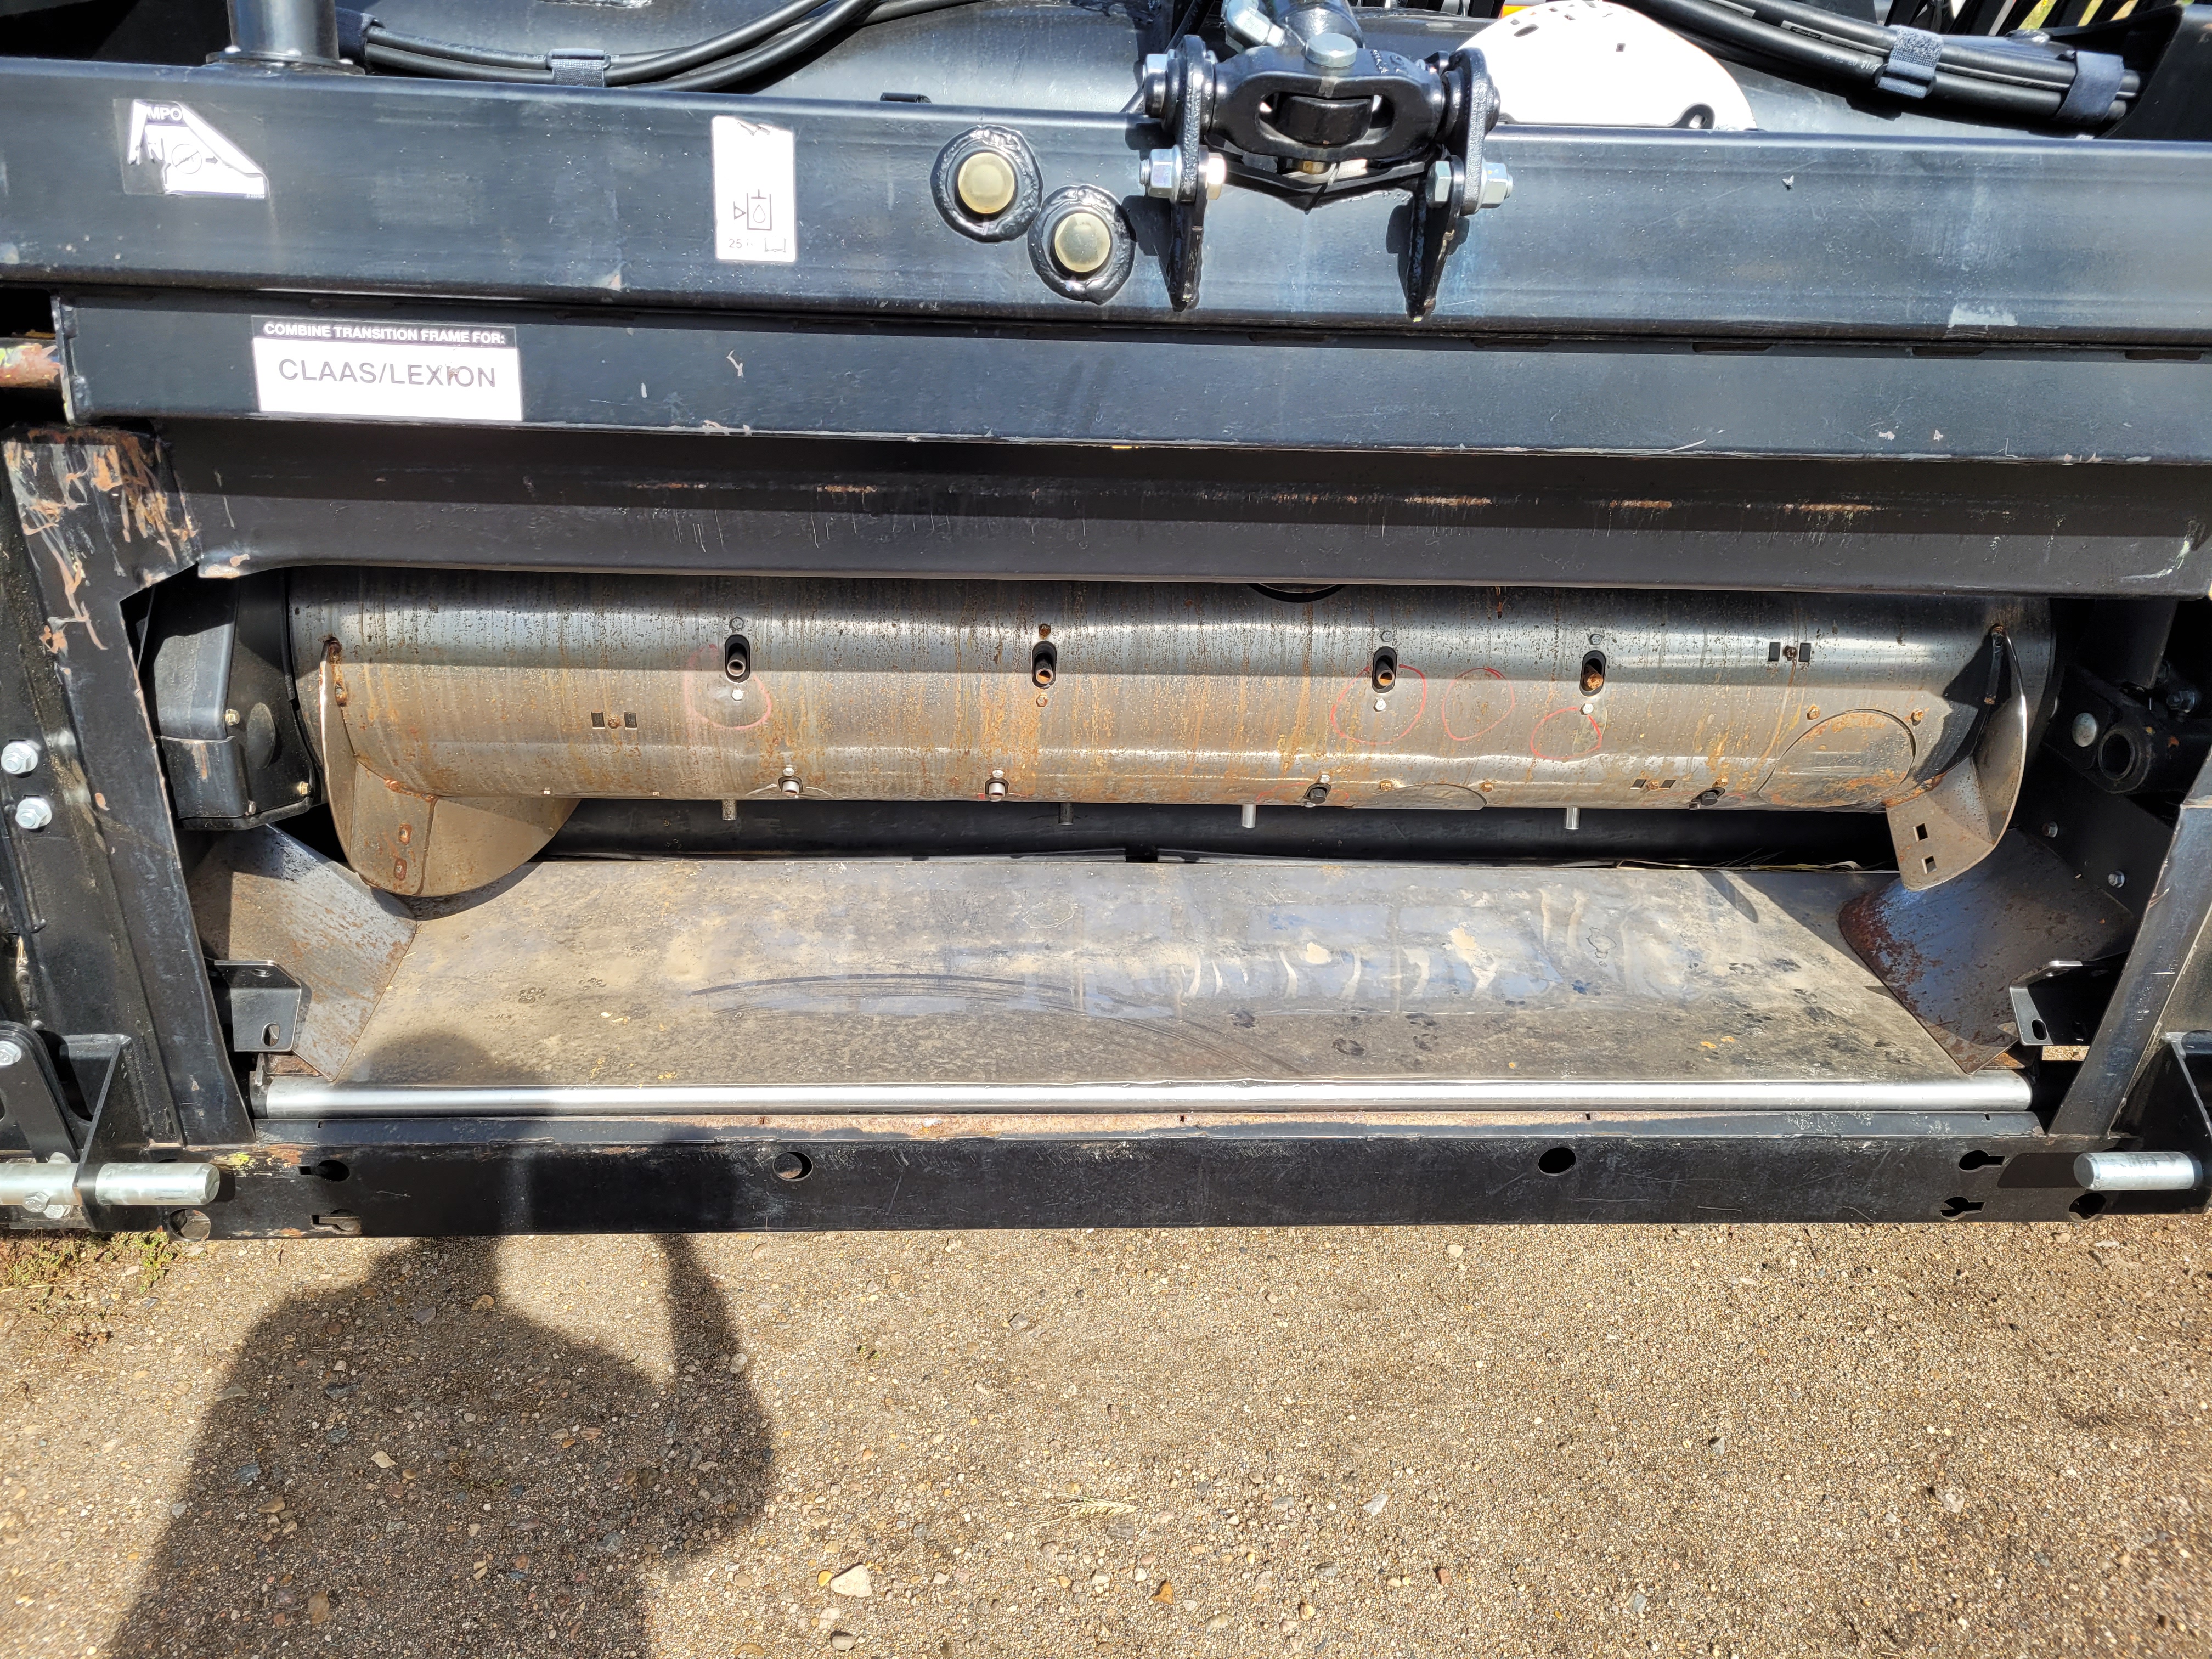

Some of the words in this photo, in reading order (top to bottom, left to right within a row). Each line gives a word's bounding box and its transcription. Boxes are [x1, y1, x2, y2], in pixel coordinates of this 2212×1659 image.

[729, 239, 743, 249] 25
[264, 323, 332, 337] COMBINE
[333, 326, 417, 341] TRANSITION
[421, 330, 470, 343] FRAME
[472, 332, 505, 345] FOR:
[279, 359, 495, 388] CLAAS/LEXION
